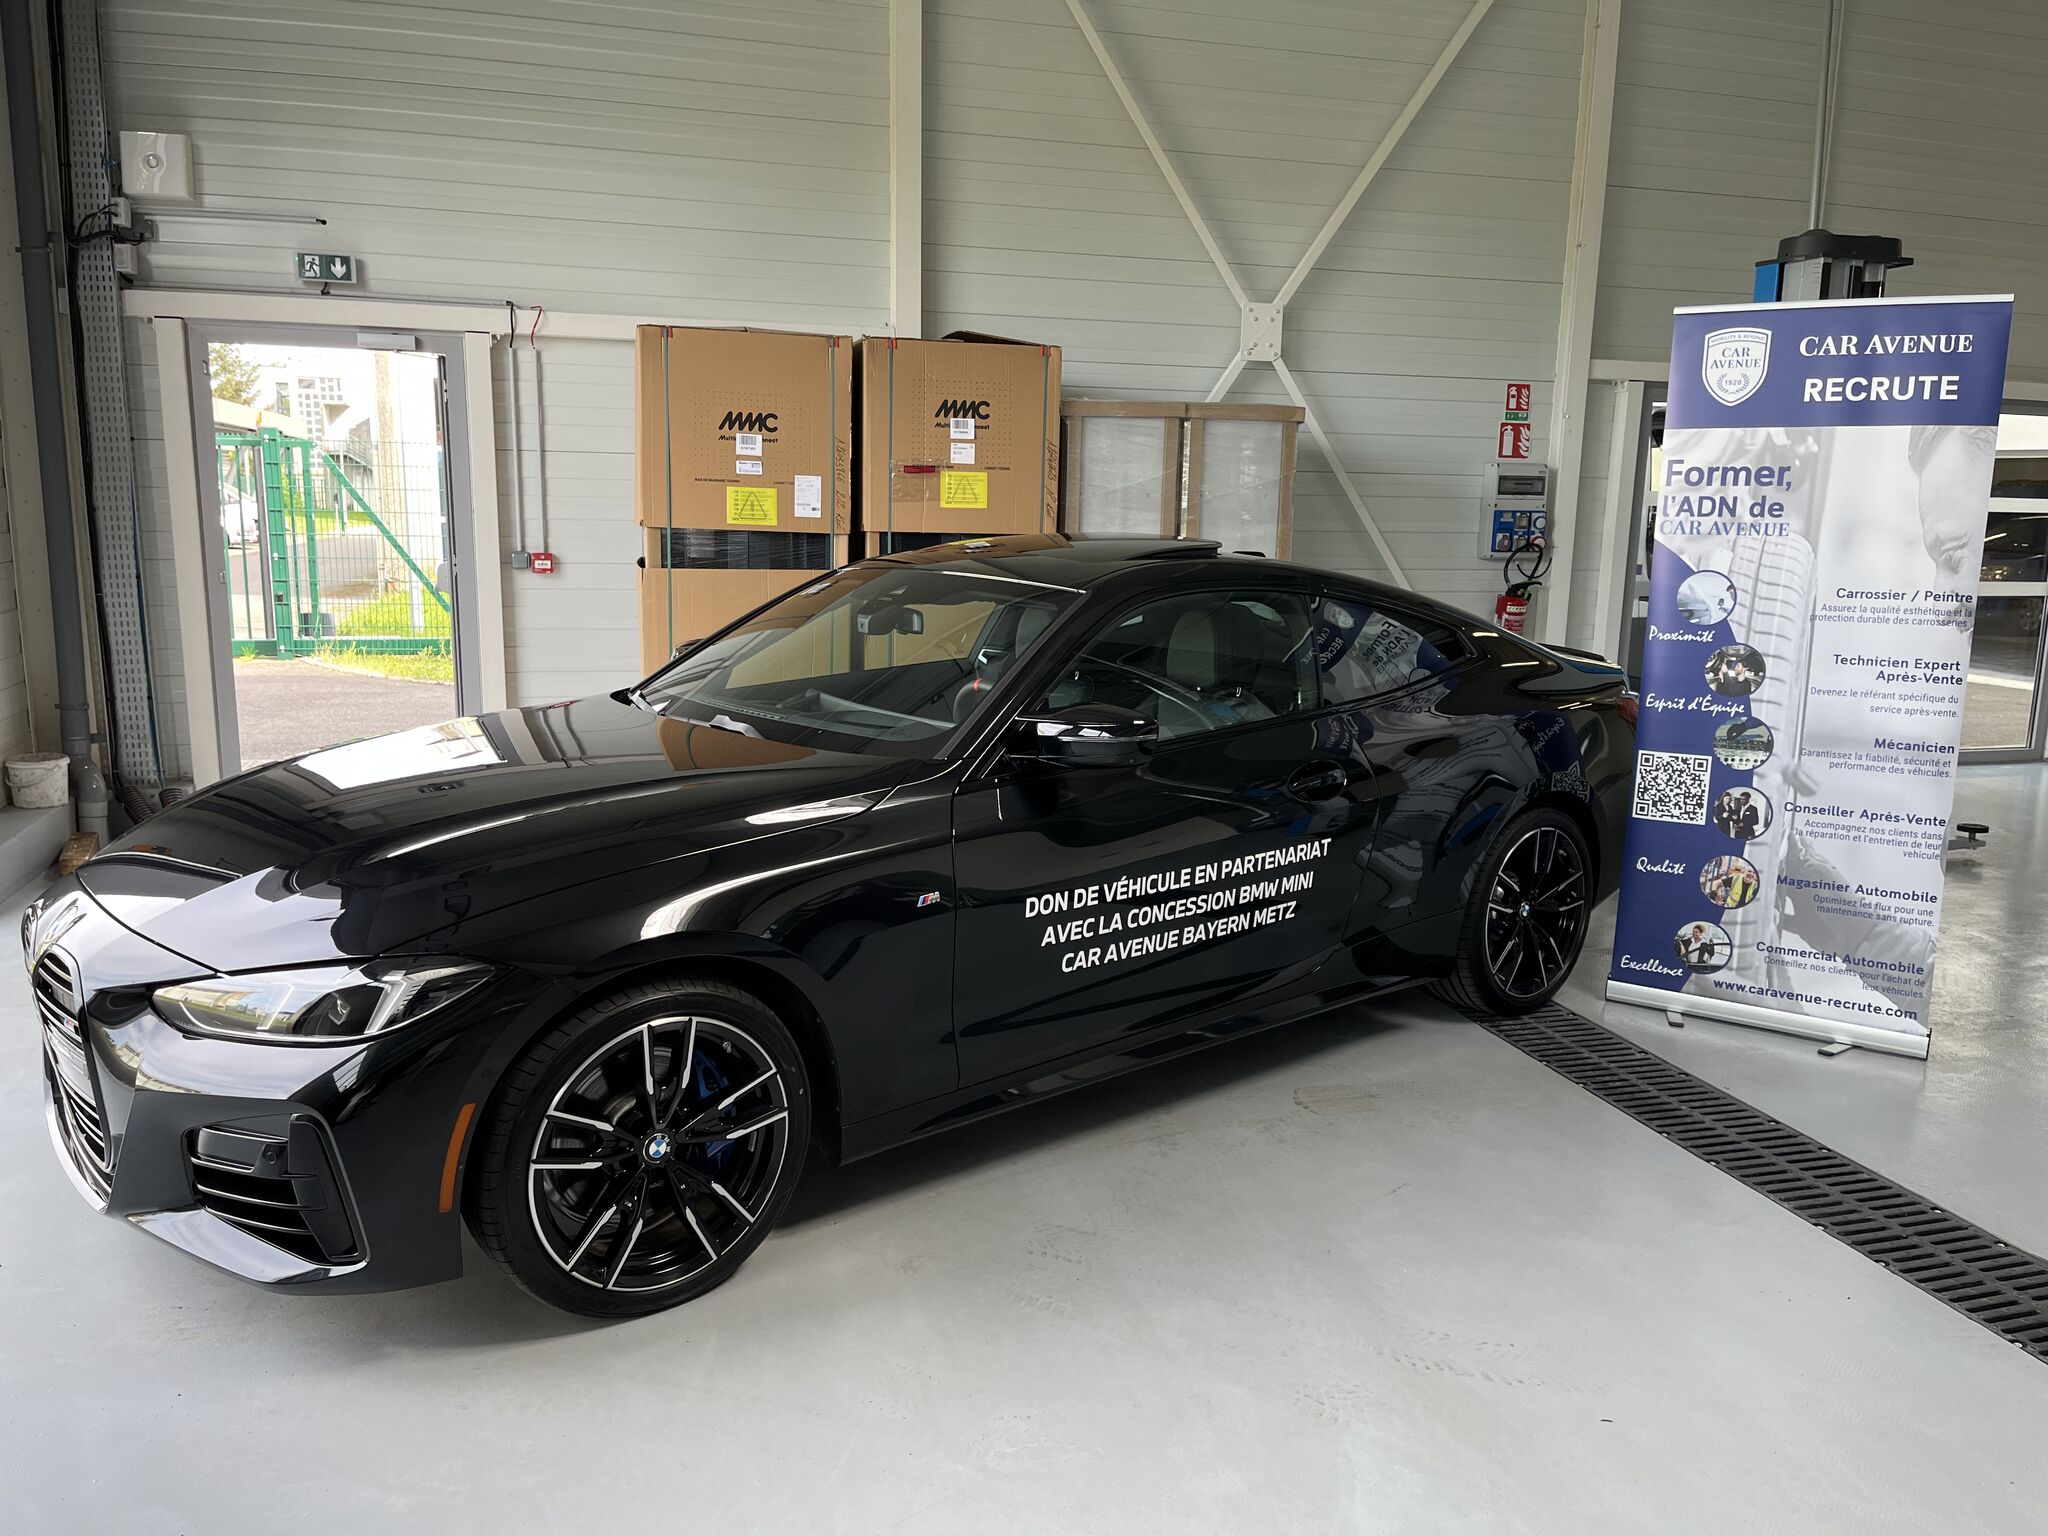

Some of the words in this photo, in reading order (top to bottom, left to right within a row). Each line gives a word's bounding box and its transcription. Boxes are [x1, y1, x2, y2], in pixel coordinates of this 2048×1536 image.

[1722, 347, 1750, 358] CAR
[1800, 335, 1858, 357] CAR
[1864, 334, 1973, 355] AVENUE
[1710, 359, 1761, 369] AVENUE
[1803, 375, 1960, 402] RECRUTE
[935, 399, 990, 420] MMC
[719, 411, 778, 433] MMC
[1666, 458, 1792, 491] Former,
[1749, 495, 1784, 518] de
[1660, 520, 1702, 536] CAR
[1708, 520, 1790, 537] AVENUE
[1836, 587, 1906, 601] Carrossier
[1911, 590, 1920, 602] /
[1924, 590, 1973, 603] Peintre
[1810, 613, 1854, 623] protection
[1857, 614, 1890, 624] durable
[1893, 616, 1909, 625] des
[1821, 604, 1856, 612] Assurez
[1859, 604, 1867, 613] la
[1870, 605, 1900, 616] qualité
[1903, 606, 1951, 617] esthétique
[1953, 608, 1963, 617] et
[1965, 608, 1972, 617] la
[1649, 625, 1715, 642] Proximité
[1834, 654, 1908, 668] Technicien
[1915, 658, 1960, 672] Expert
[1876, 670, 1963, 685] Après-Vente
[1646, 693, 1686, 712] Esprit
[1810, 687, 1847, 696] Devenez
[1850, 689, 1858, 698] le
[1860, 690, 1895, 700] référant
[1898, 692, 1945, 704] spécifique
[1948, 695, 1959, 704] du
[1870, 705, 1901, 714] service
[1904, 707, 1959, 718] après-vente.
[1874, 738, 1955, 754] Mécanicien
[1800, 748, 1852, 760] Garantissez
[1855, 752, 1862, 761] la
[1904, 757, 1940, 767] sécurité
[1943, 760, 1951, 768] et
[1829, 761, 1886, 773] performance
[1888, 765, 1904, 774] des
[1907, 767, 1951, 778] véhicules.
[1784, 801, 1855, 818] Conseiller
[1859, 809, 1946, 827] Après-Vente
[1796, 828, 1803, 836] la
[1806, 828, 1850, 841] réparation
[1853, 834, 1861, 842] et
[1864, 834, 1908, 848] l'entretien
[1911, 839, 1922, 849] de
[1925, 841, 1942, 851] leur
[1804, 819, 1866, 834] Accompagnez
[1869, 826, 1885, 836] nos
[1888, 828, 1918, 839] clients
[1921, 831, 1942, 841] dans
[1636, 857, 1686, 875] Qualité
[1024, 890, 1068, 918] DON
[1073, 885, 1100, 910] DE
[1103, 867, 1191, 902] VÉHICULE
[1194, 862, 1218, 884] EN
[1221, 838, 1332, 879] PARTENARIAT
[1776, 874, 1850, 893] Magasinier
[1855, 884, 1938, 903] Automobile
[1040, 917, 1095, 947] AVEC
[1098, 912, 1123, 935] LA
[1127, 888, 1236, 928] CONCESSION
[1239, 878, 1280, 905] BMW
[1281, 870, 1314, 895] MINI
[1813, 894, 1856, 908] Optimisez
[1859, 898, 1873, 910] les
[1874, 901, 1891, 912] flux
[1894, 905, 1914, 916] pour
[1917, 908, 1934, 917] une
[1817, 904, 1873, 919] maintenance
[1876, 912, 1897, 923] sans
[1900, 917, 1935, 927] rupture.
[1061, 947, 1101, 973] CAR
[1103, 929, 1179, 964] AVENUE
[1182, 911, 1250, 946] BAYERN
[1253, 901, 1297, 928] METZ
[1620, 955, 1683, 976] Excellence
[1756, 942, 1837, 963] Commercial
[1842, 955, 1924, 975] Automobile
[1764, 956, 1808, 970] Conseillez
[1810, 963, 1826, 972] nos
[1828, 965, 1856, 977] clients
[1860, 971, 1880, 983] pour
[1914, 978, 1926, 988] de
[1863, 982, 1879, 992] leur
[1713, 979, 1917, 1021] www.caravenue-recrute.com
